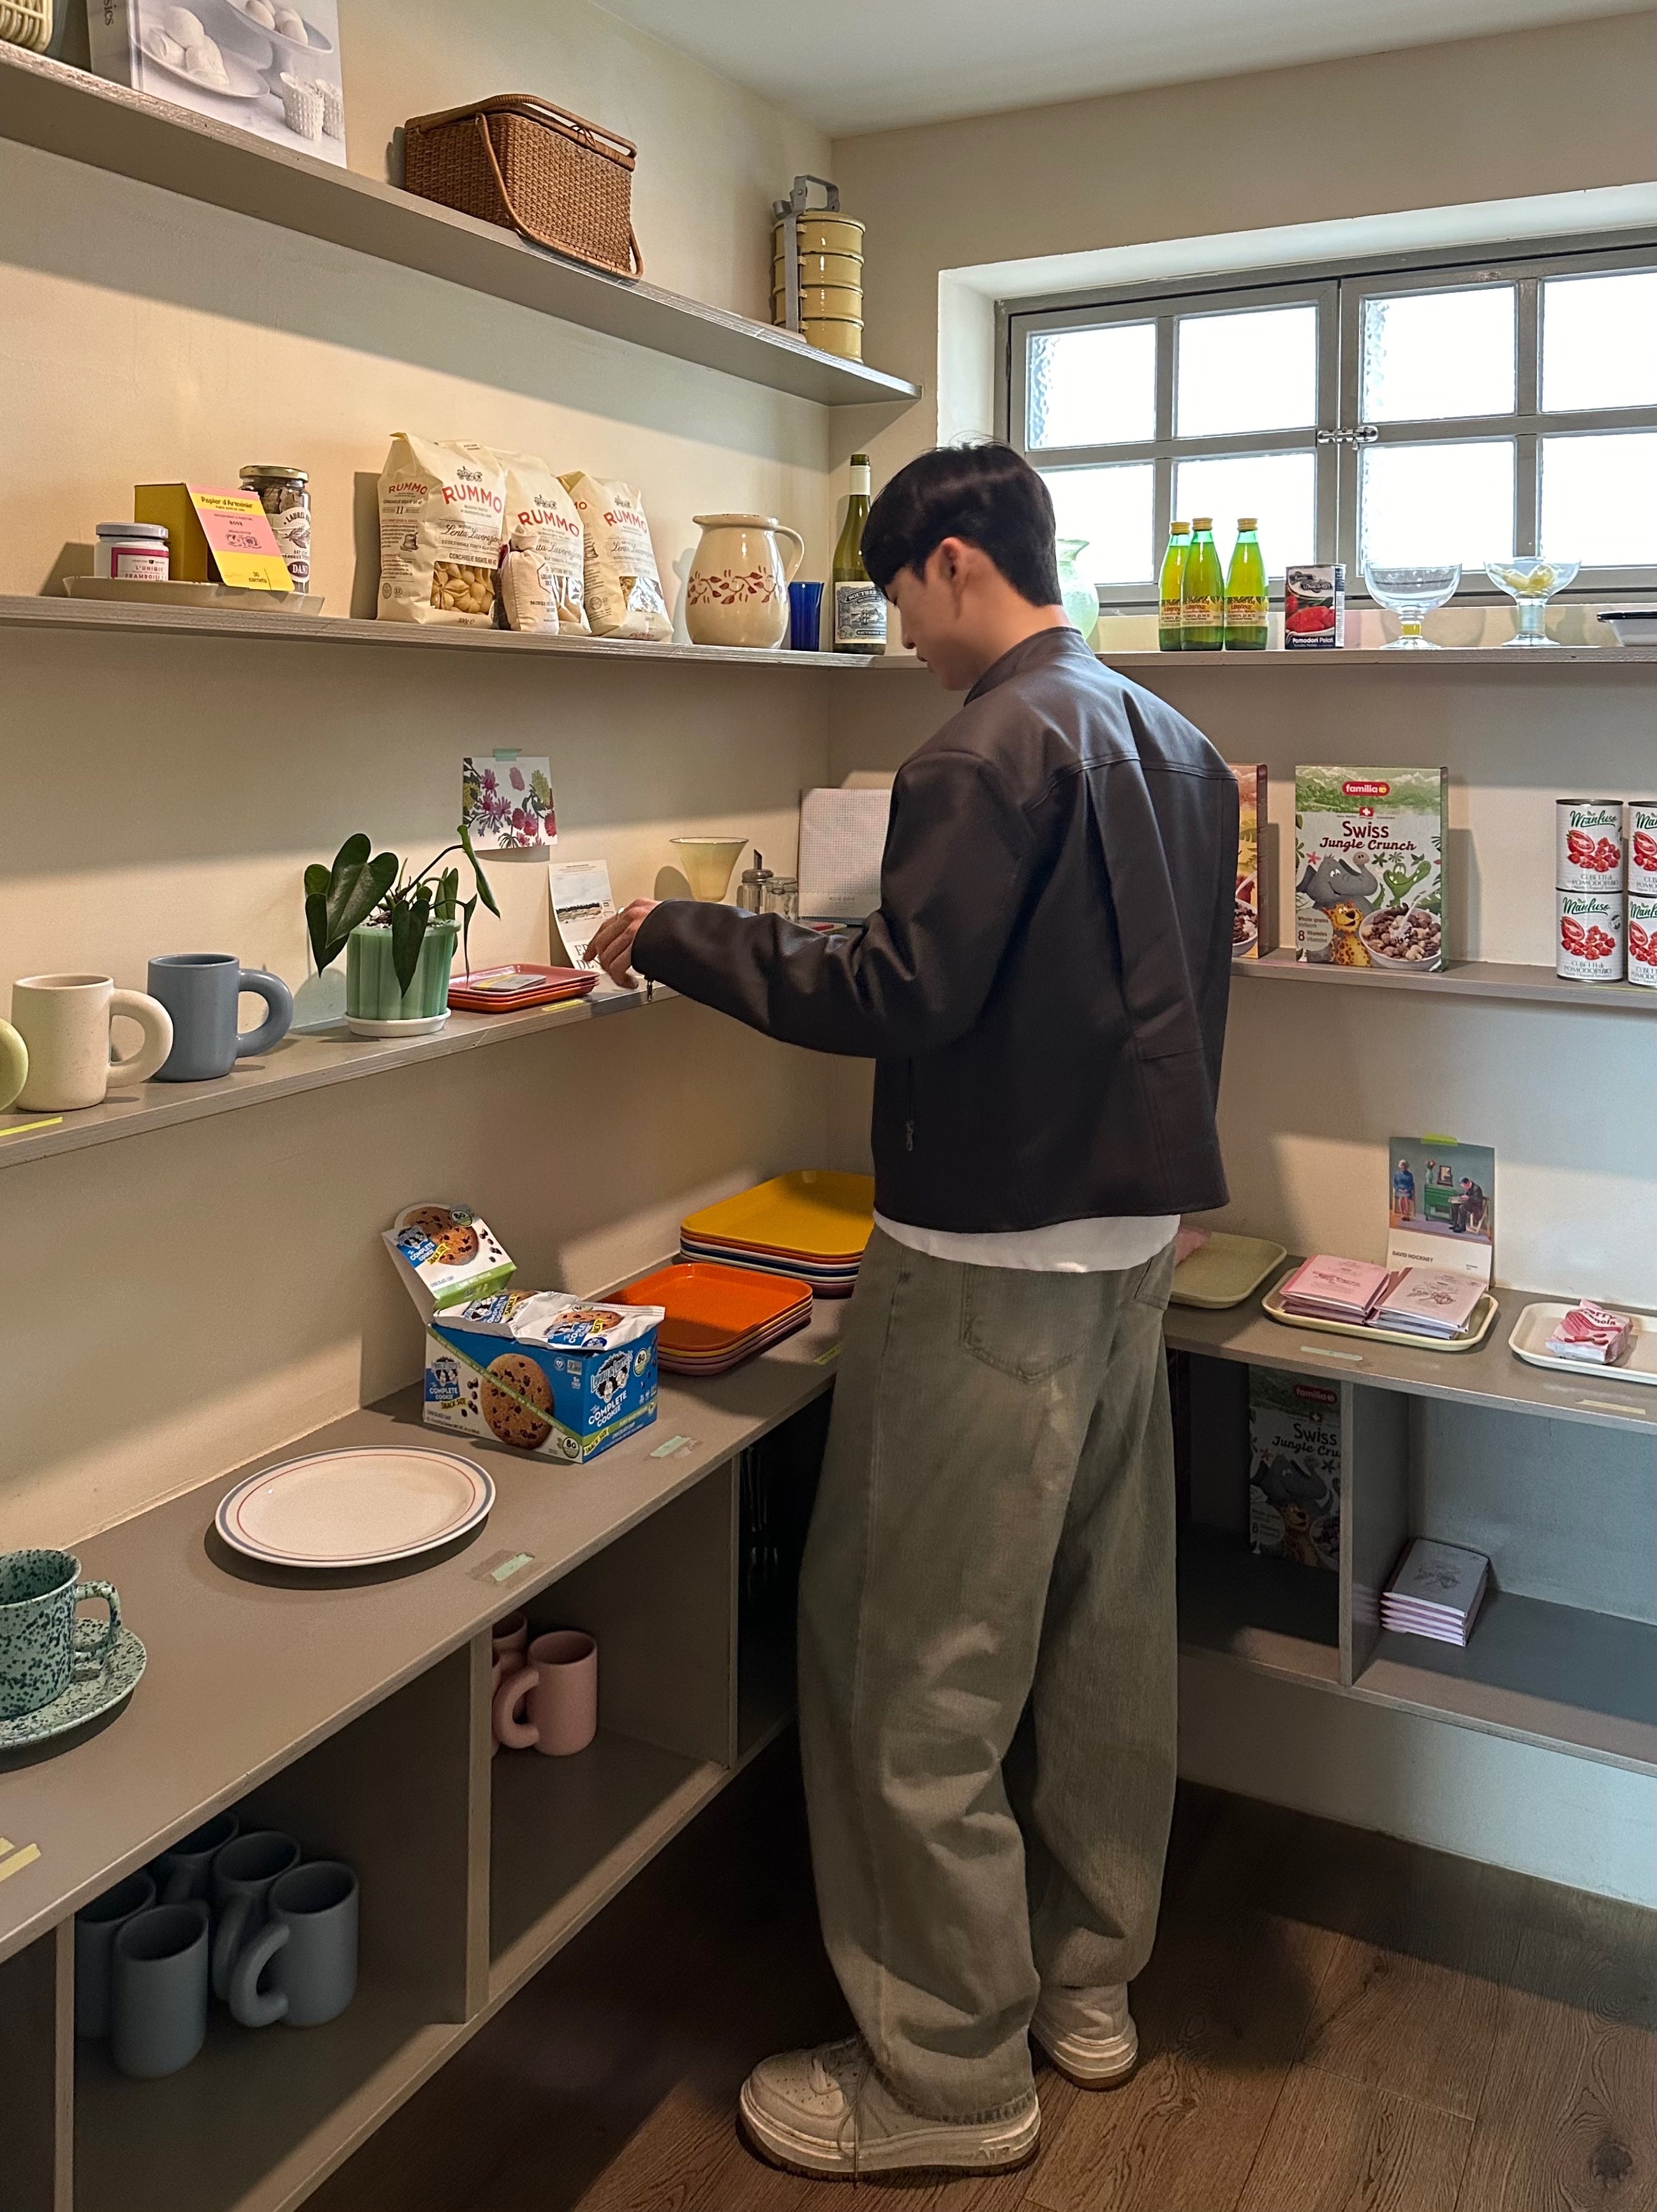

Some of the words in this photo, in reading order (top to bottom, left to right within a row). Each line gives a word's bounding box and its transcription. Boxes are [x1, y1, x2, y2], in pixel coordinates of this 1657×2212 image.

[389, 482, 427, 495] RUMMO
[200, 496, 221, 505] Papier
[442, 484, 502, 513] RUMMO
[517, 509, 579, 537] RUMMO
[603, 509, 647, 534] RUMMO
[440, 524, 469, 536] Lenta
[1345, 784, 1378, 793] familia
[1342, 821, 1389, 839] Swiss
[1319, 837, 1365, 852] Jungle
[1367, 839, 1417, 851] Crunch
[1298, 930, 1305, 941] 8
[409, 1241, 435, 1261] COMPLETE
[427, 1252, 440, 1265] SNACK
[1408, 1253, 1434, 1263] HOCKNEY
[1297, 1387, 1326, 1400] familia
[588, 1390, 627, 1424] COMPLETE
[597, 1403, 622, 1427] COOKIE
[1293, 1423, 1337, 1446] Swiss
[566, 1440, 576, 1449] 8G
[1272, 1435, 1316, 1454] Jungle
